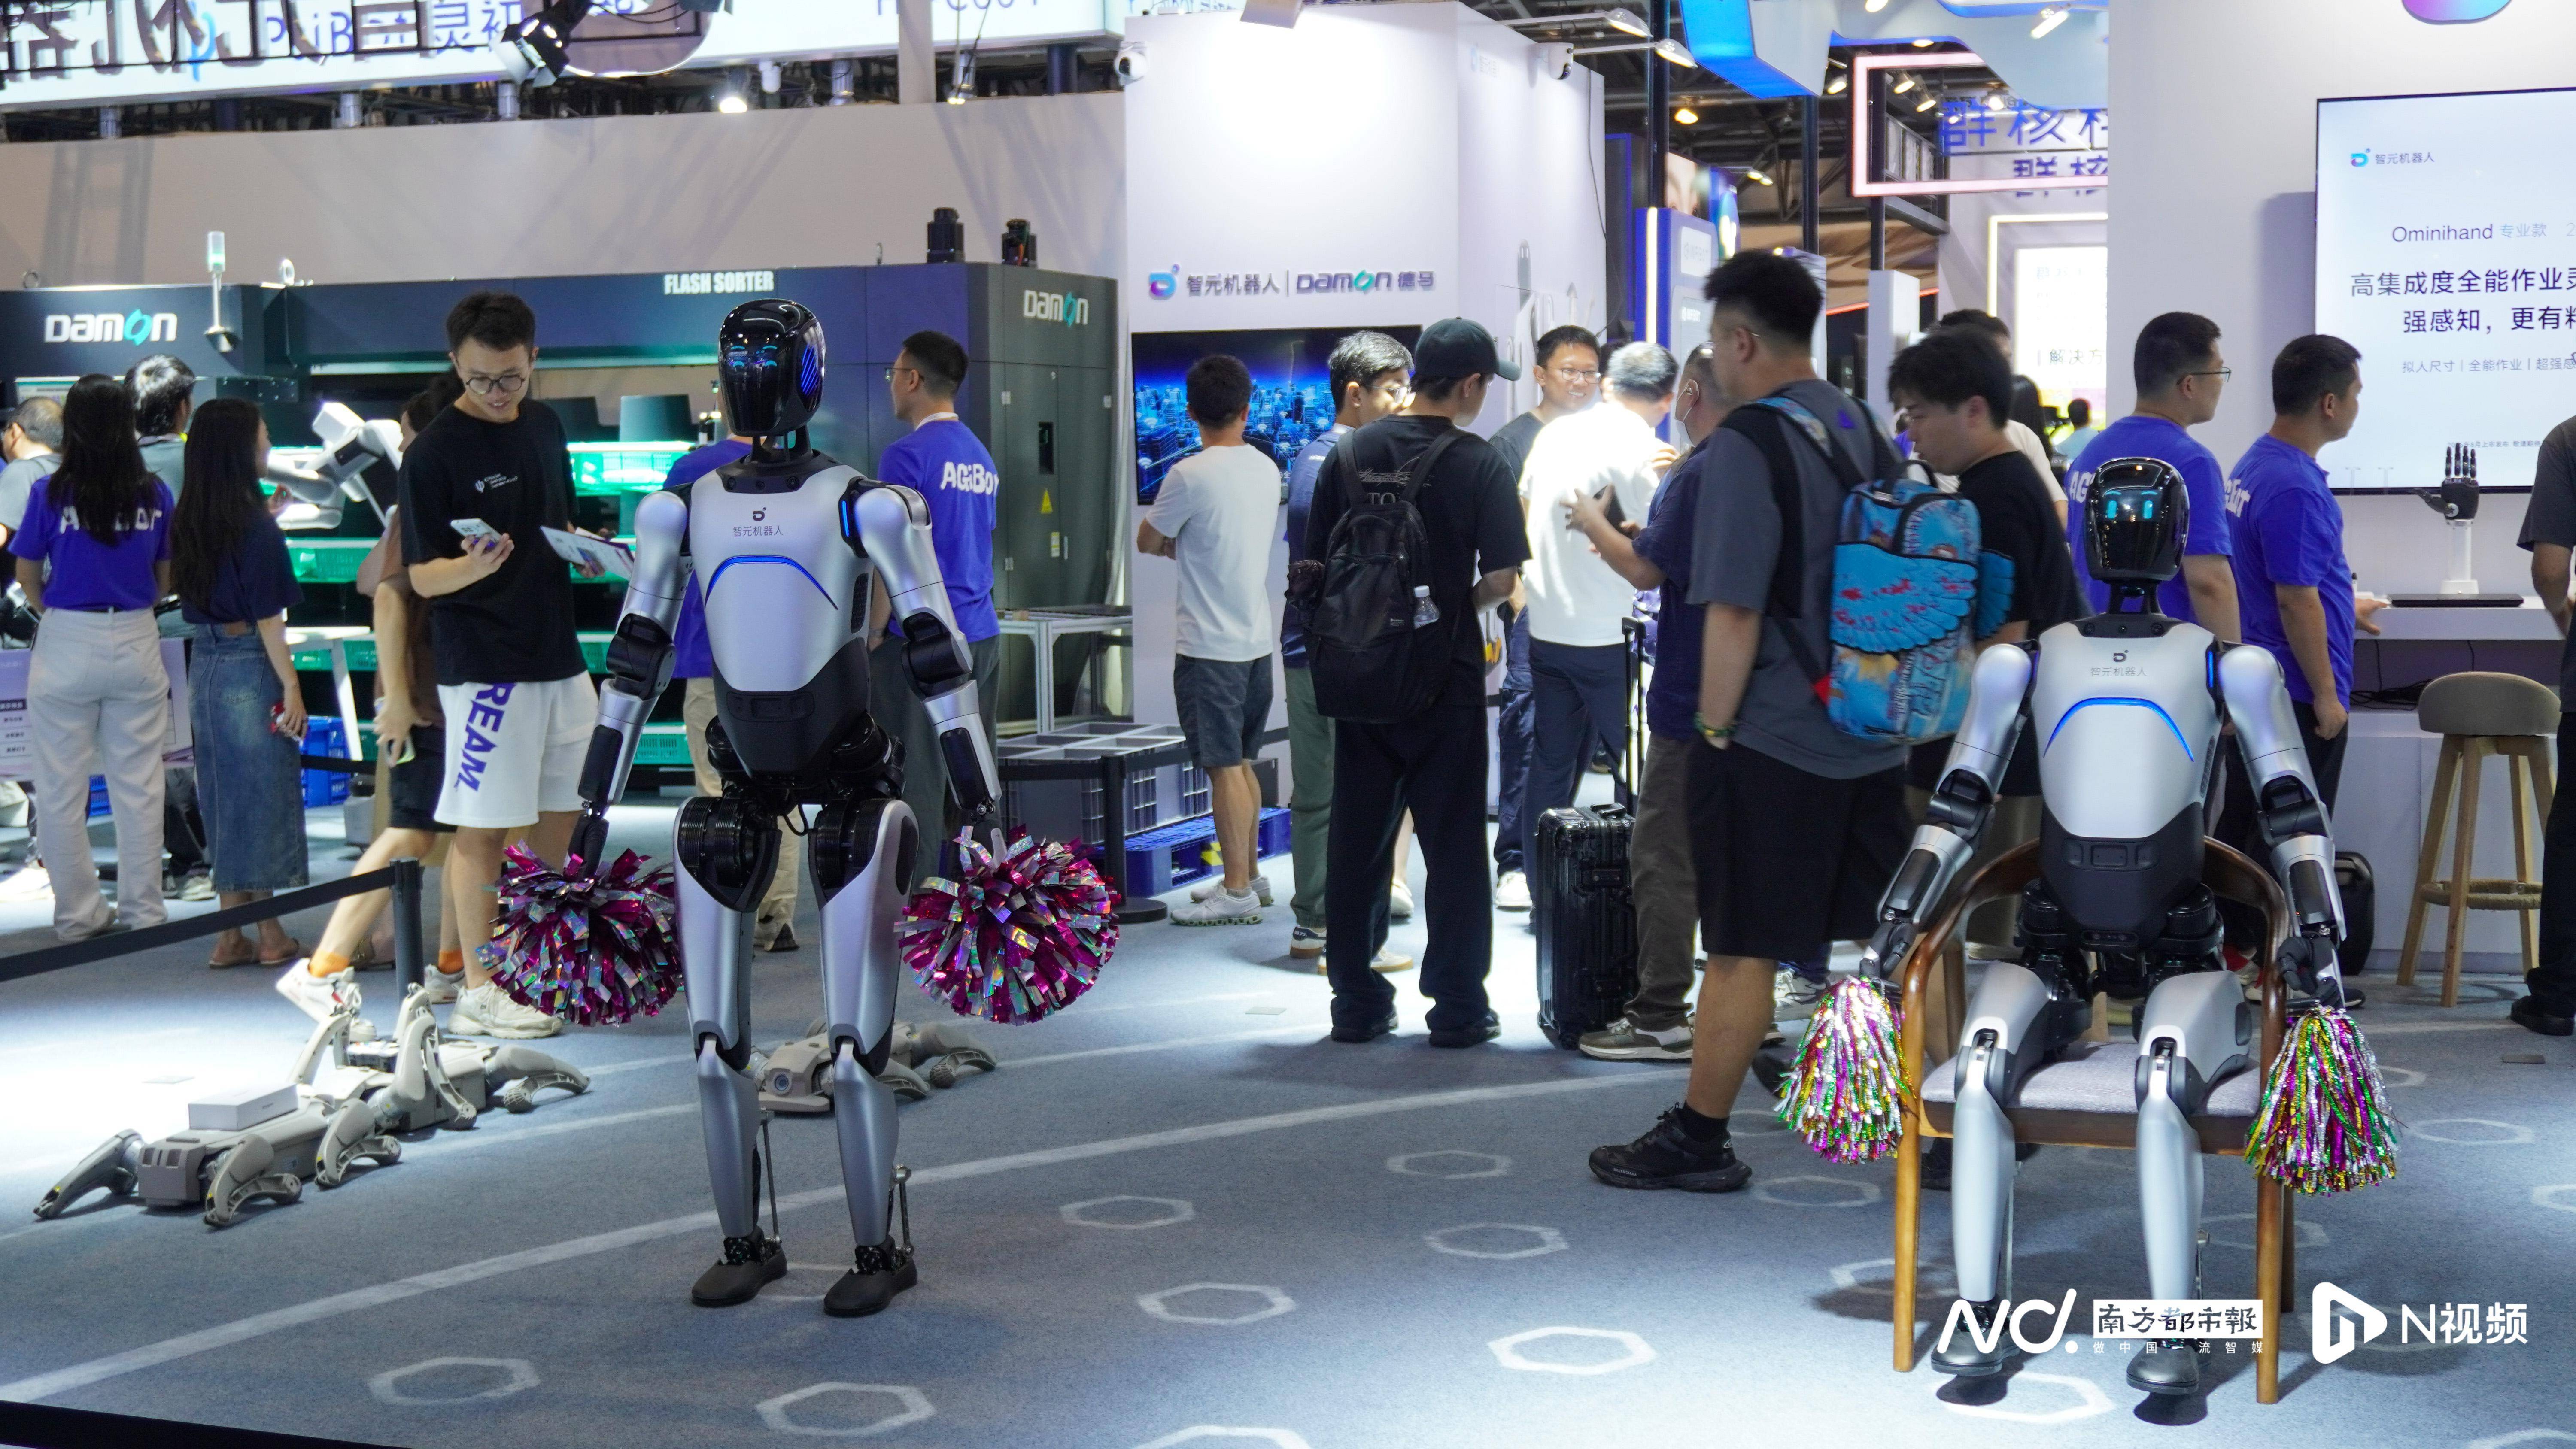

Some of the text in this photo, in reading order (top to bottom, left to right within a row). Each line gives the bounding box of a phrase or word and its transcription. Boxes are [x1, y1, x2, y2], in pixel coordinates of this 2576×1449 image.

[2375, 152, 2435, 165] 智元机器人
[2392, 224, 2493, 243] Ominihand
[2500, 223, 2547, 238] 专业款
[664, 271, 774, 295] FLASH SORTER
[1186, 273, 1280, 297] 智元机器人
[1397, 270, 1434, 288] 德马
[2402, 360, 2455, 373] 拟人尺寸
[2469, 359, 2522, 371] 全能作业
[732, 525, 784, 537] 智元机器人
[2090, 667, 2148, 677] 智元机器人
